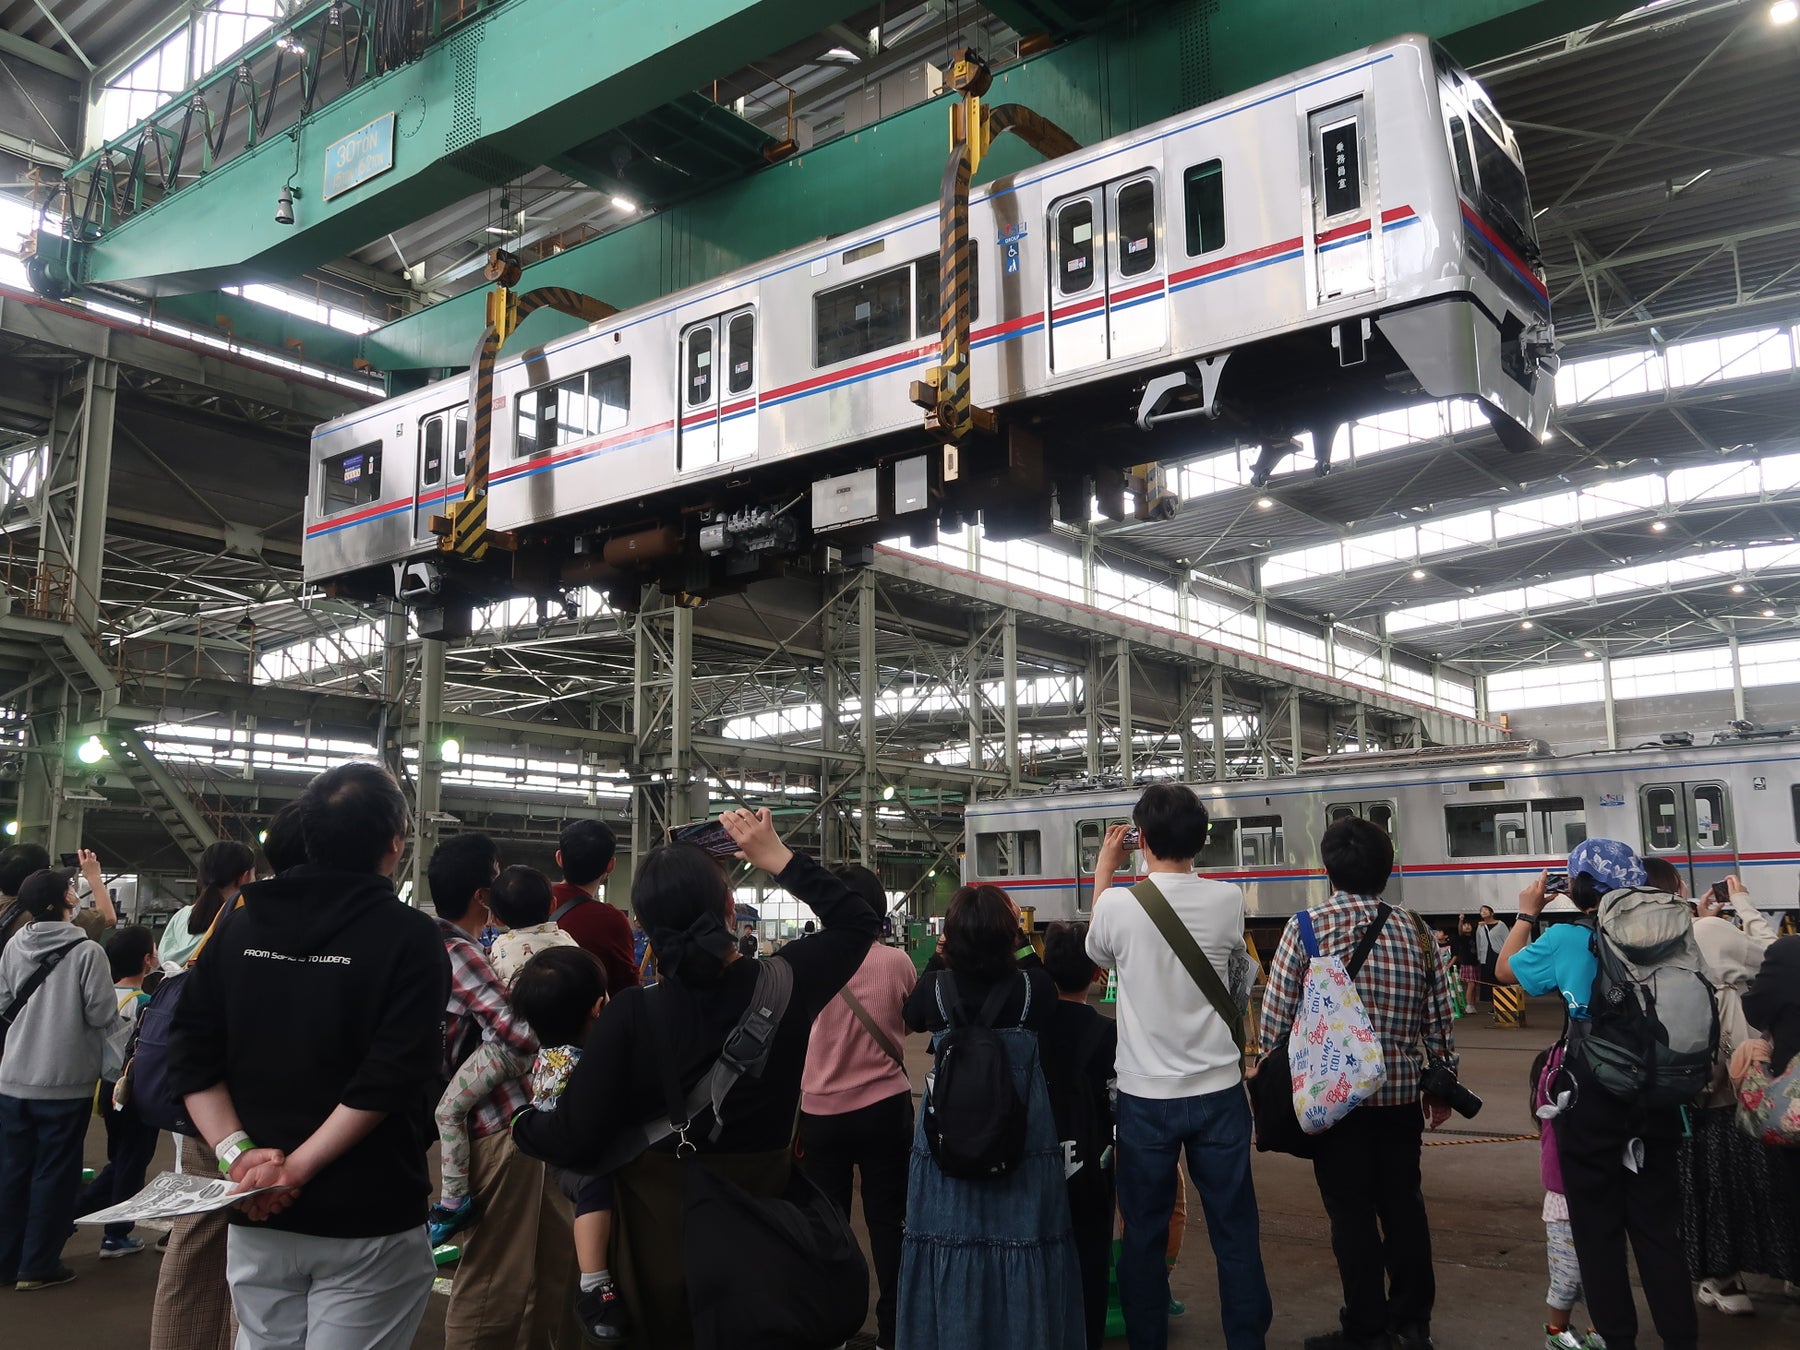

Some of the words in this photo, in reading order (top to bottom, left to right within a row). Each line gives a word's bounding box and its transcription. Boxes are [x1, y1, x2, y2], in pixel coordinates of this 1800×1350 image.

[244, 949, 270, 958] FROM
[308, 955, 319, 963] TO
[319, 955, 351, 965] LUDENS
[1320, 1036, 1334, 1076] BEAMS
[1330, 1047, 1341, 1071] GOLF
[1305, 1105, 1328, 1120] BEAMS
